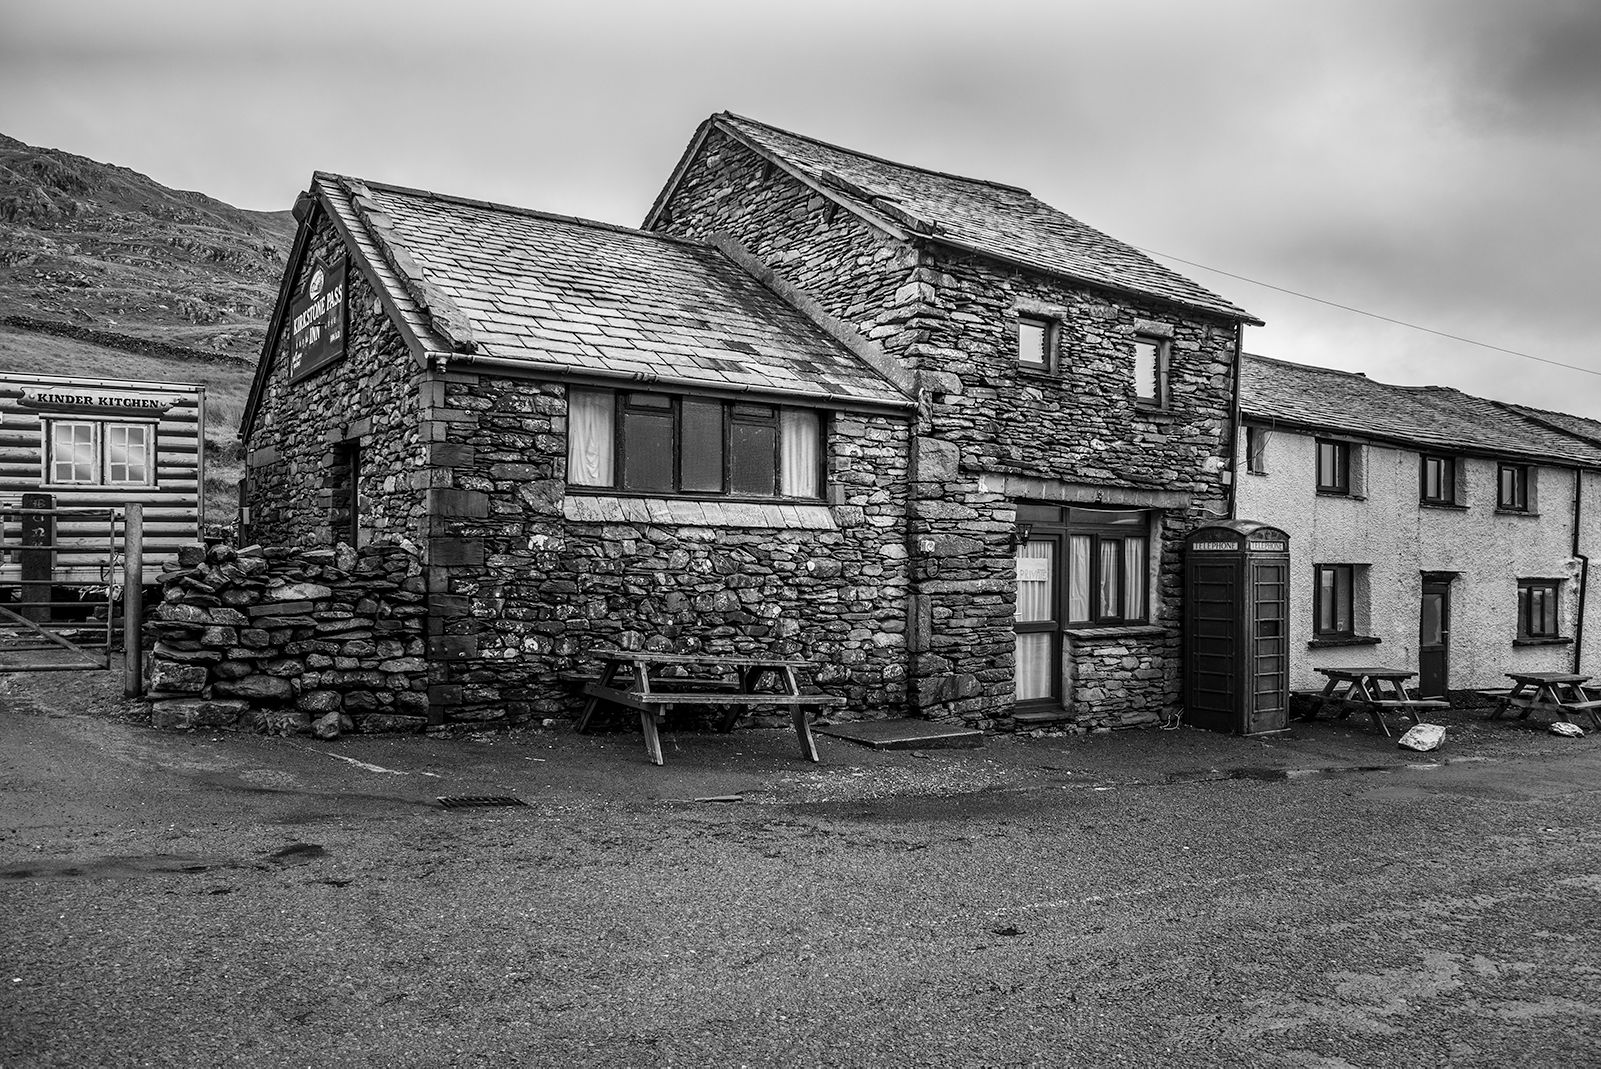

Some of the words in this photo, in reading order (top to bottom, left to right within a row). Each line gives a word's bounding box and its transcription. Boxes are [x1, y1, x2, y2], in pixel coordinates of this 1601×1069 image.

[293, 296, 326, 336] KIRKSTONE
[326, 284, 343, 312] PASS
[309, 322, 321, 345] INN
[37, 393, 94, 405] KINDER
[98, 396, 160, 409] KITCHEN
[1194, 542, 1237, 550] TELEPHONE
[1251, 542, 1284, 551] TELEPHONE
